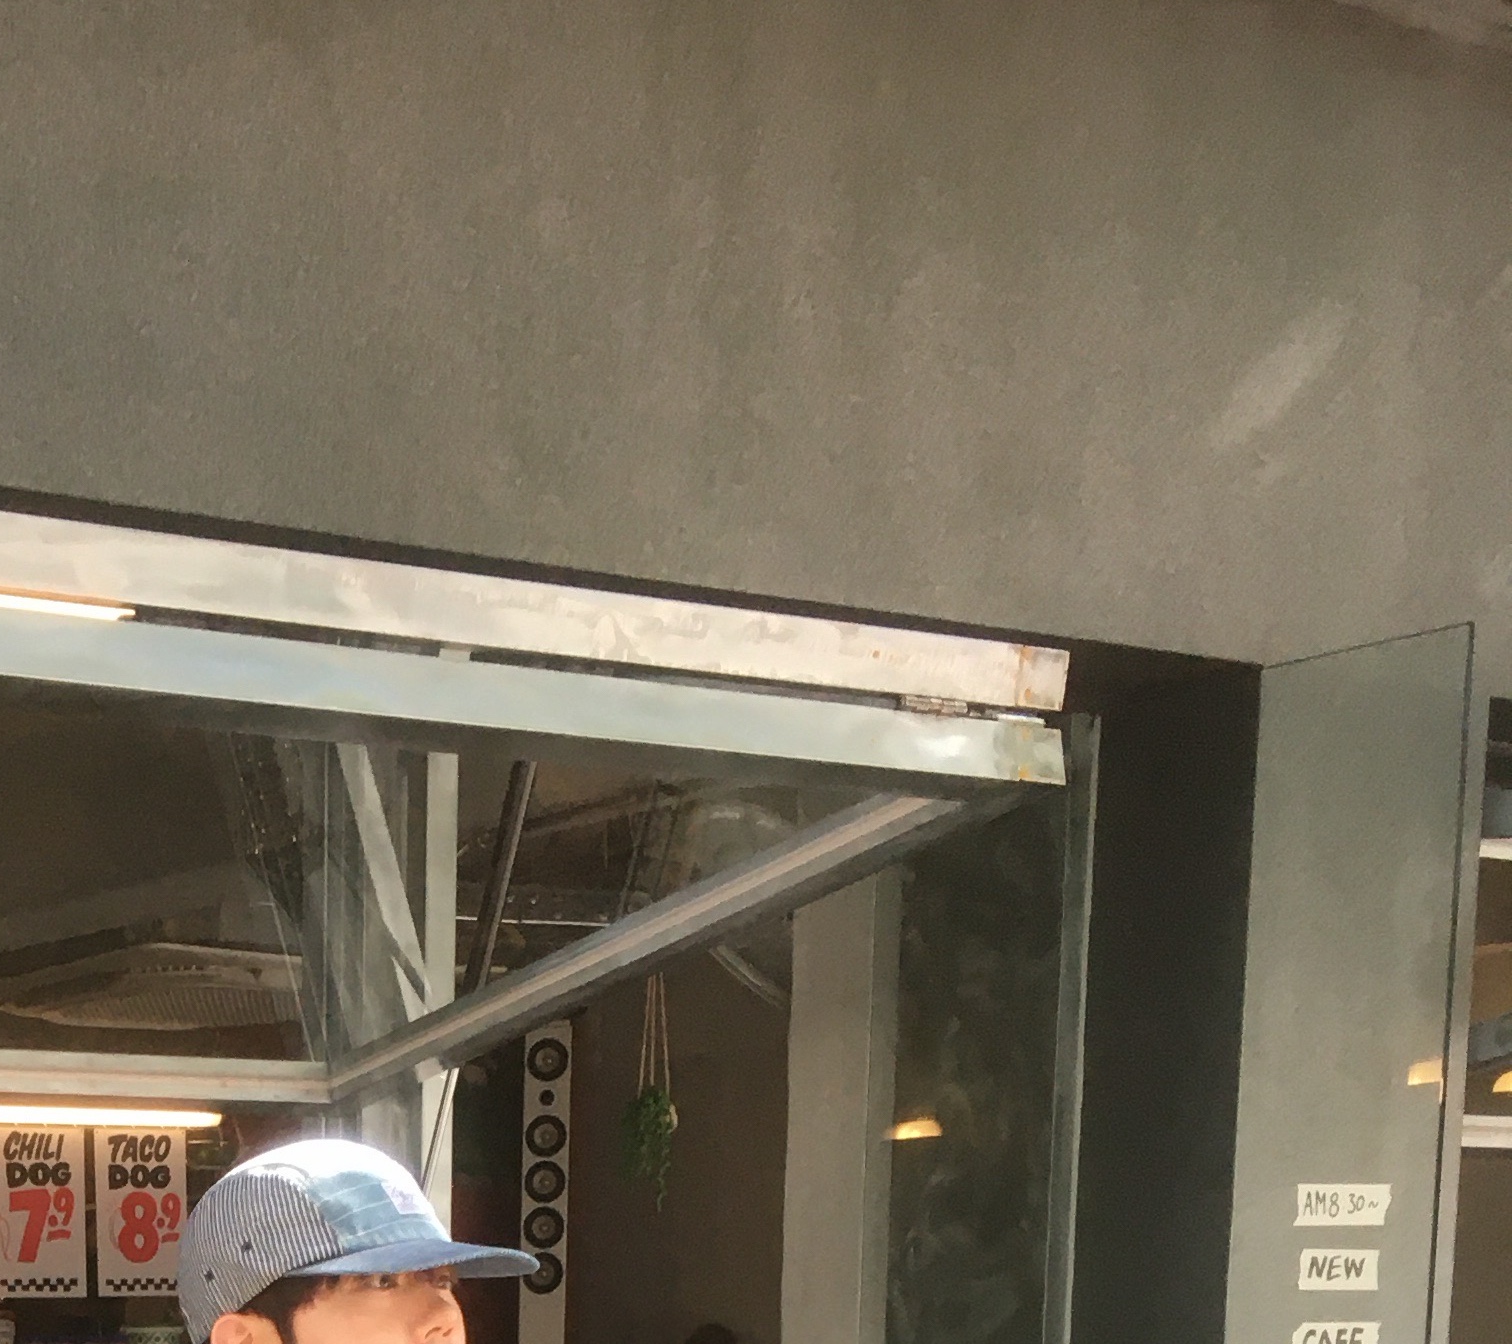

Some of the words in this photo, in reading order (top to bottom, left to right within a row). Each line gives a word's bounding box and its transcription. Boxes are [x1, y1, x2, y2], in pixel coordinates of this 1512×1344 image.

[3, 1130, 65, 1161] CHILI
[107, 1134, 172, 1163] TACO
[5, 1161, 72, 1188] DOG
[108, 1164, 171, 1190] DOG
[1307, 1255, 1366, 1282] NEW
